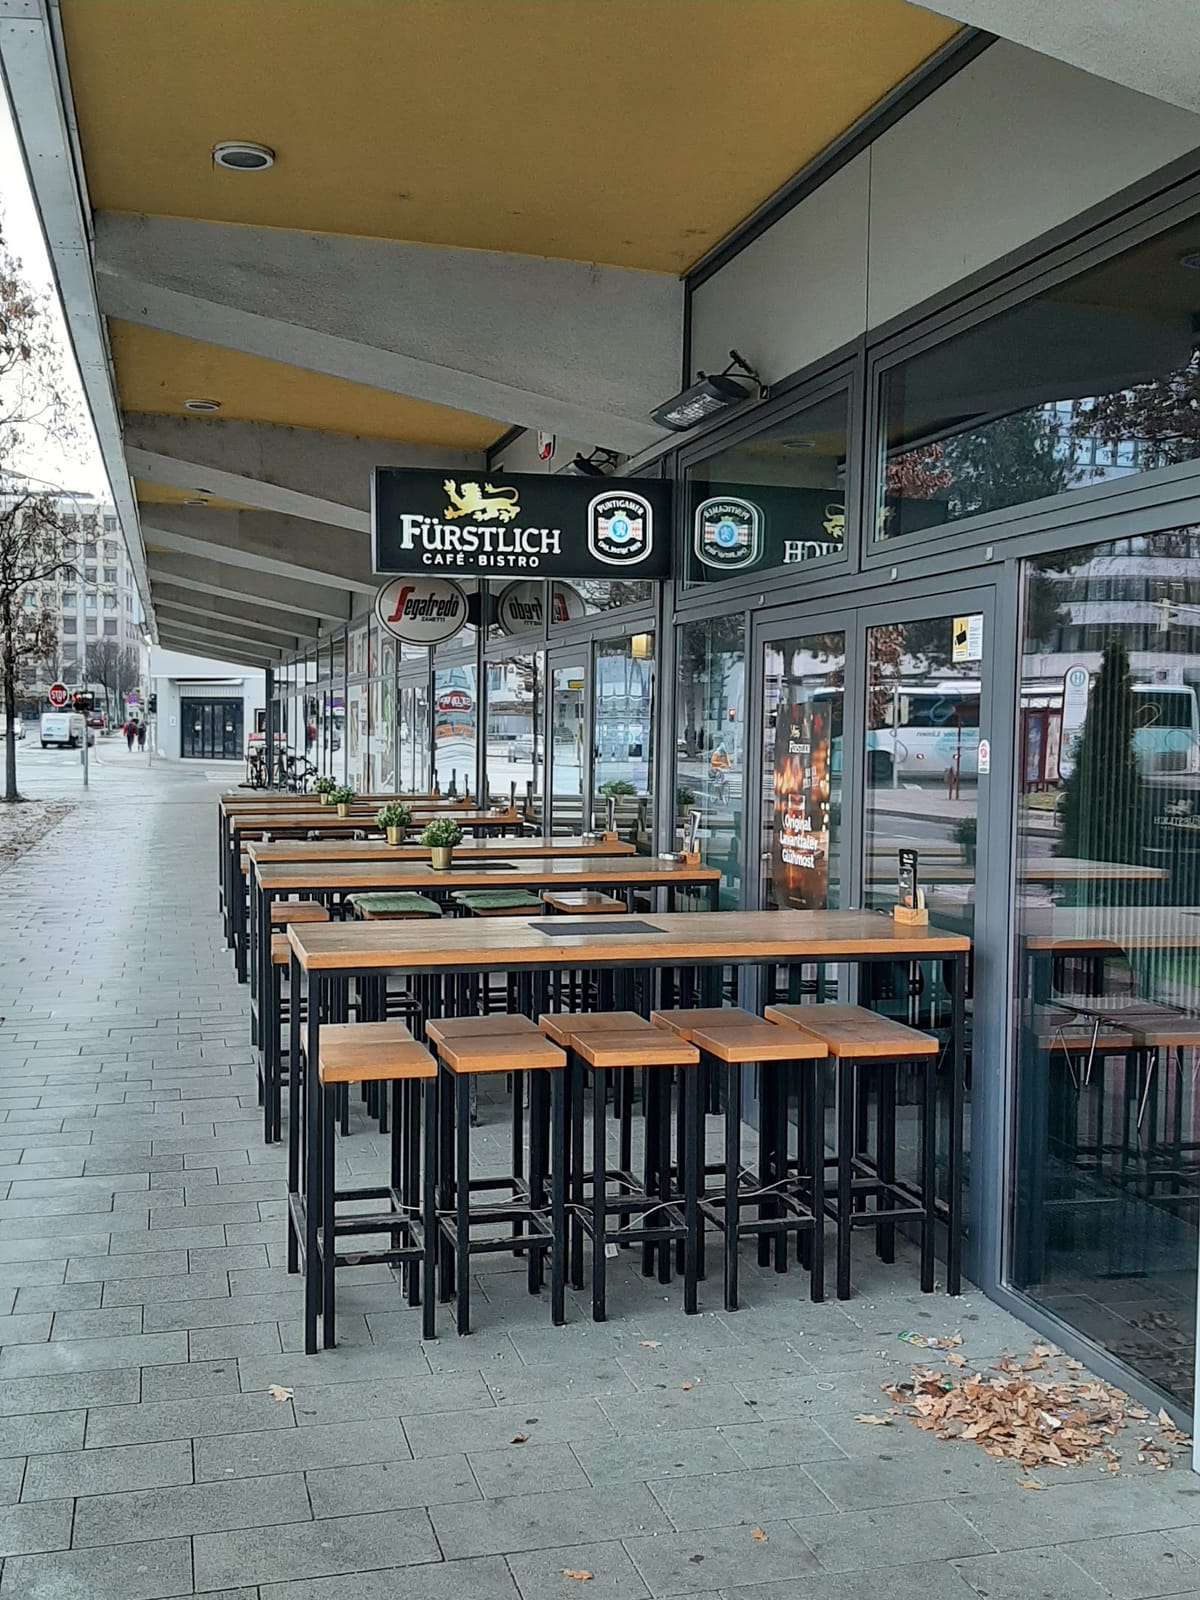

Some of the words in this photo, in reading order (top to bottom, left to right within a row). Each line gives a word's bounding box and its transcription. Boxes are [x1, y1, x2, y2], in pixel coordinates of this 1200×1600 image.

[399, 514, 562, 555] FÜRSTLICH
[422, 552, 465, 566] CAFÉ
[478, 555, 540, 568] BISTRO
[387, 586, 460, 623] Segafredo
[51, 690, 67, 702] STOP
[785, 814, 812, 832] Original
